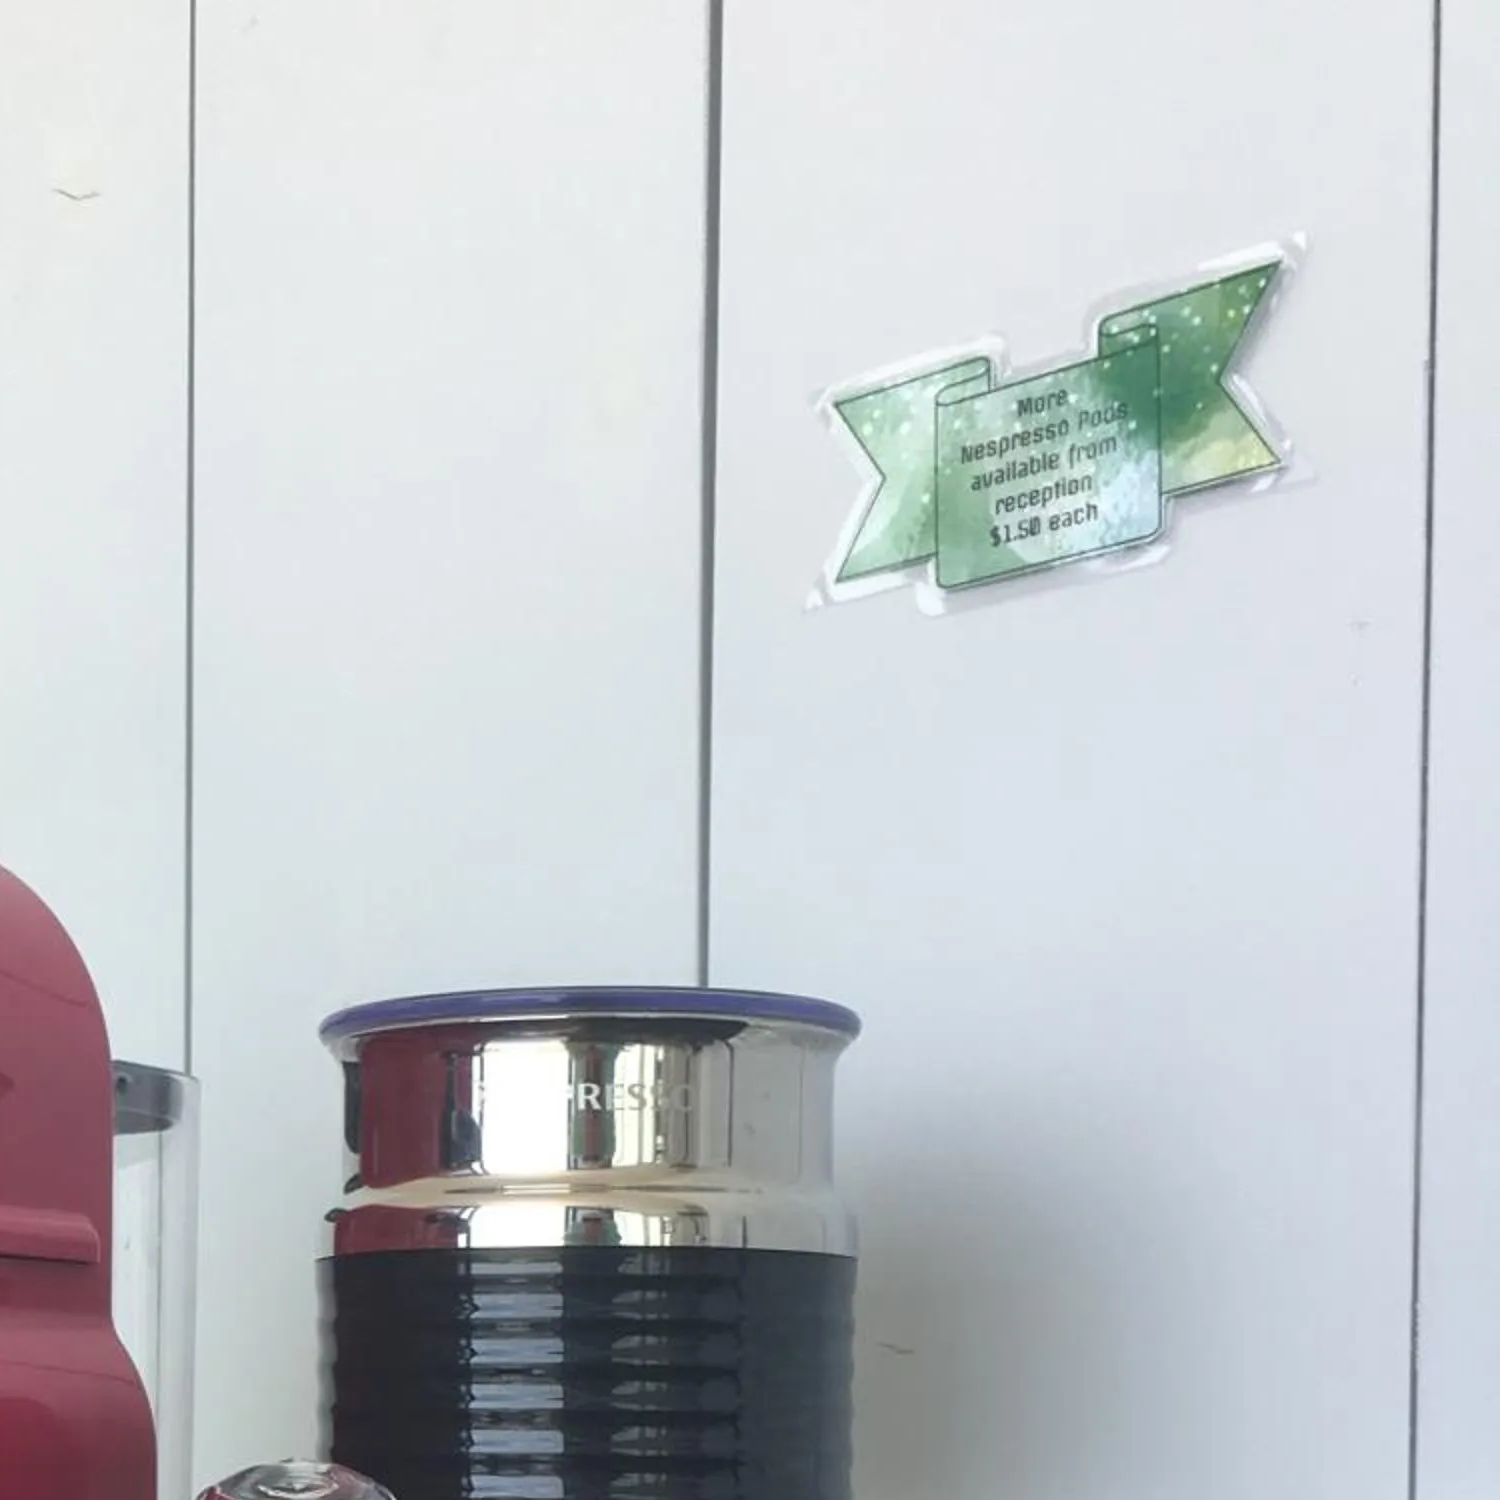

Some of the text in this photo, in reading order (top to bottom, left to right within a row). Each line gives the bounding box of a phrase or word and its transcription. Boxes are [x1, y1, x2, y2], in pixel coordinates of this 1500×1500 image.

[1016, 388, 1069, 418] More
[961, 401, 1129, 464] Nespresso Pods
[970, 435, 1118, 492] available from
[994, 474, 1093, 515] reception
[988, 501, 1099, 547] $1.50 each
